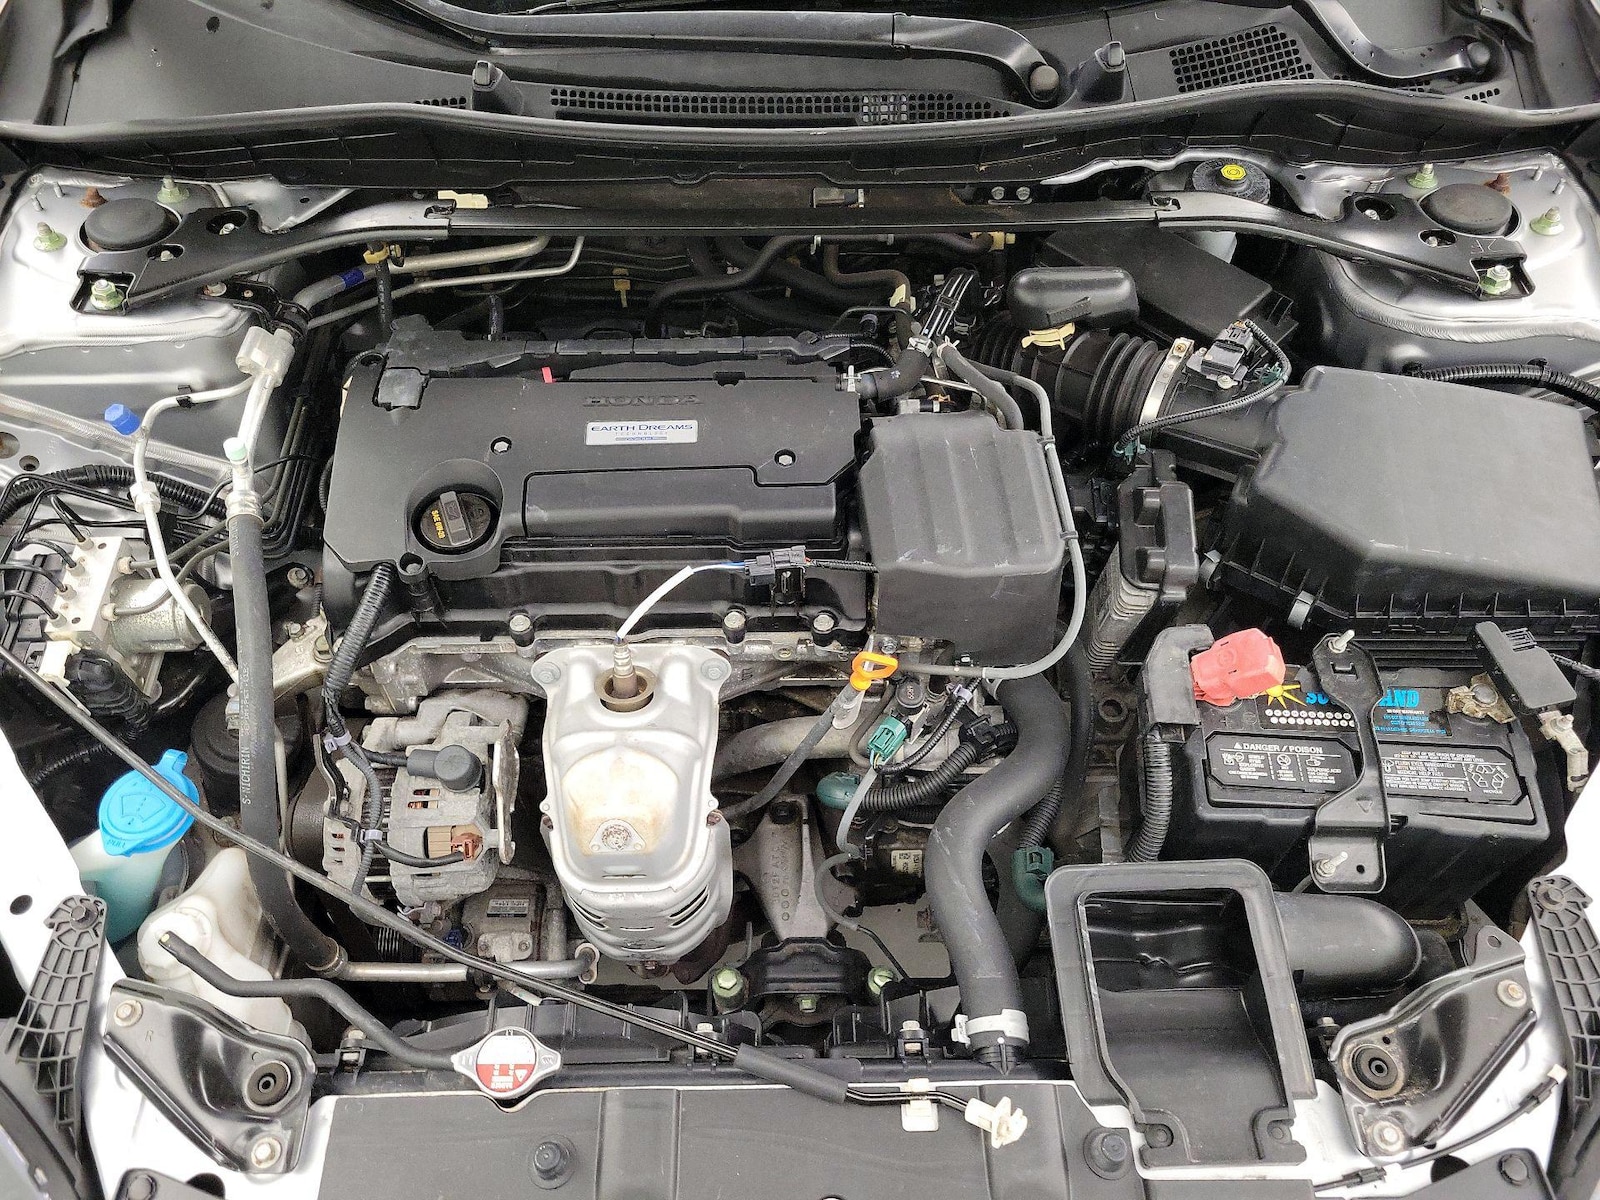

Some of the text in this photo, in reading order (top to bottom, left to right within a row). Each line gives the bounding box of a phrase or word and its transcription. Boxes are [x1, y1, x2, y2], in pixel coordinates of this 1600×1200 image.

[591, 423, 693, 432] EARTH DREAMS
[431, 510, 441, 522] SAE
[1243, 742, 1280, 751] DANGER
[1289, 745, 1323, 754] POISON
